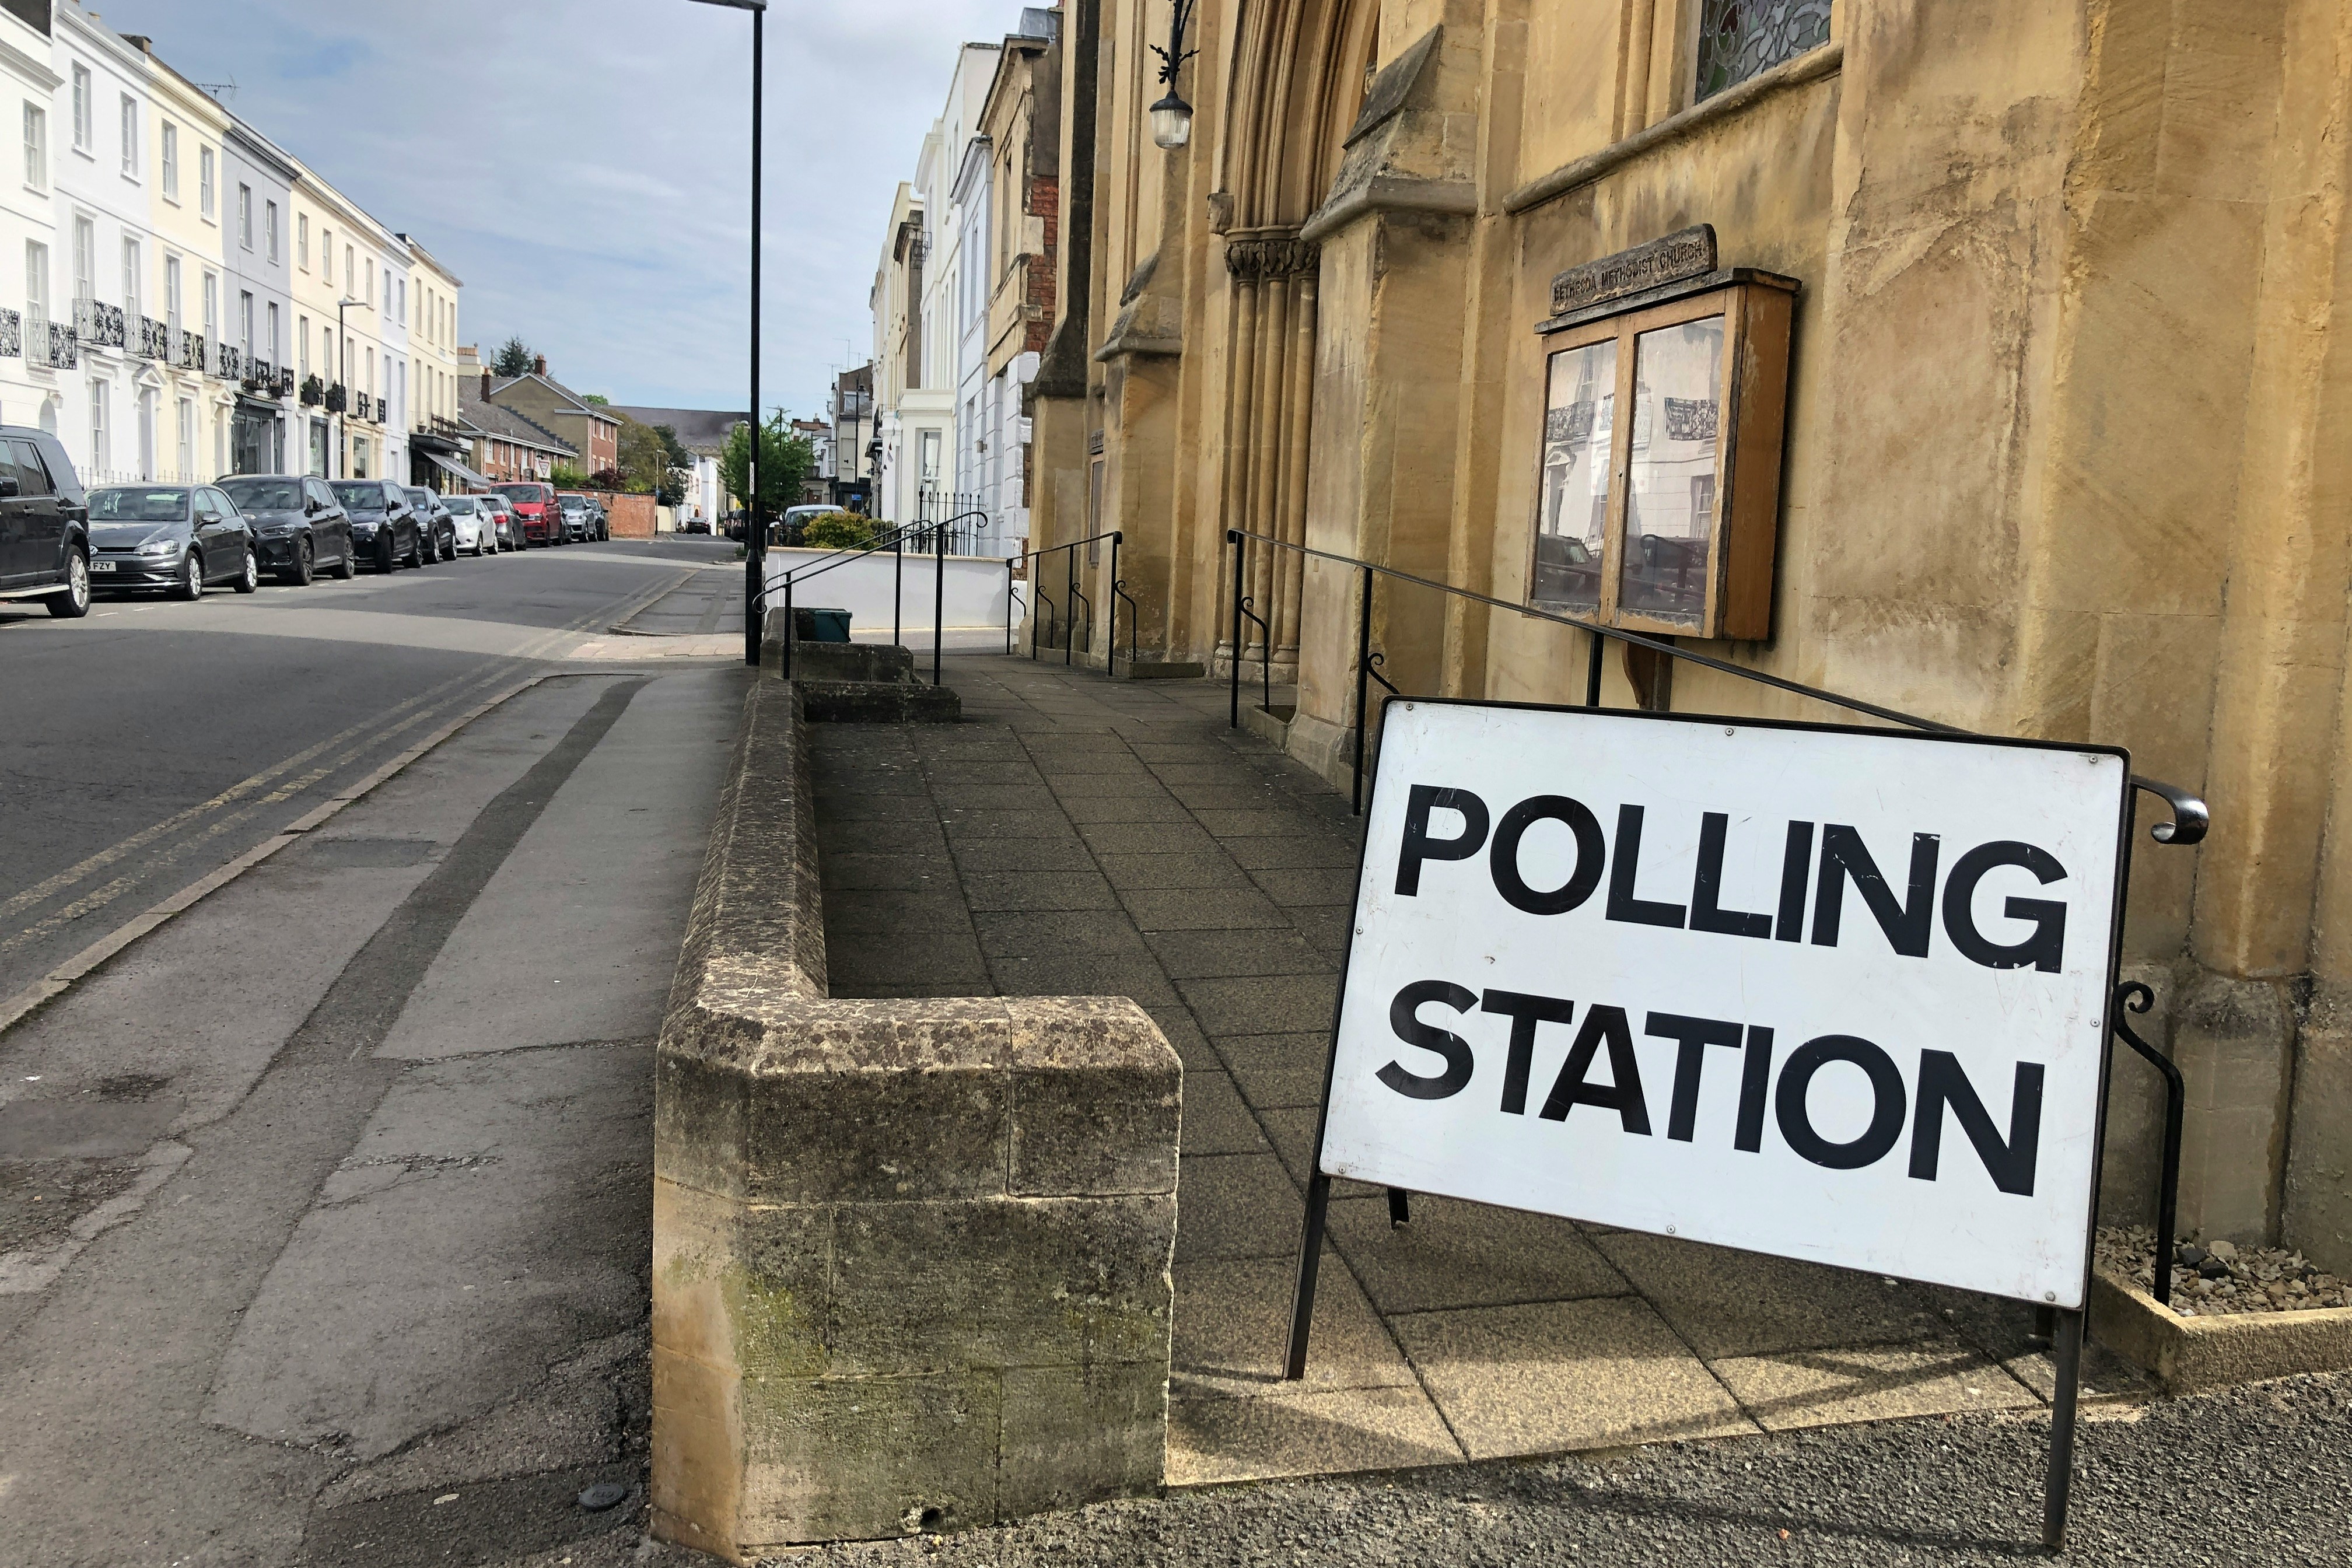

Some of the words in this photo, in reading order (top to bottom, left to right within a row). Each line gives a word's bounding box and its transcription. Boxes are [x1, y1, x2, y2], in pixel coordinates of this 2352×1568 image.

[1553, 275, 1597, 302] BETHESDA
[1601, 256, 1654, 286] METHODIST
[1659, 239, 1703, 269] CHURCH
[1395, 785, 2067, 974] POLLING
[1377, 980, 2045, 1197] STATION
